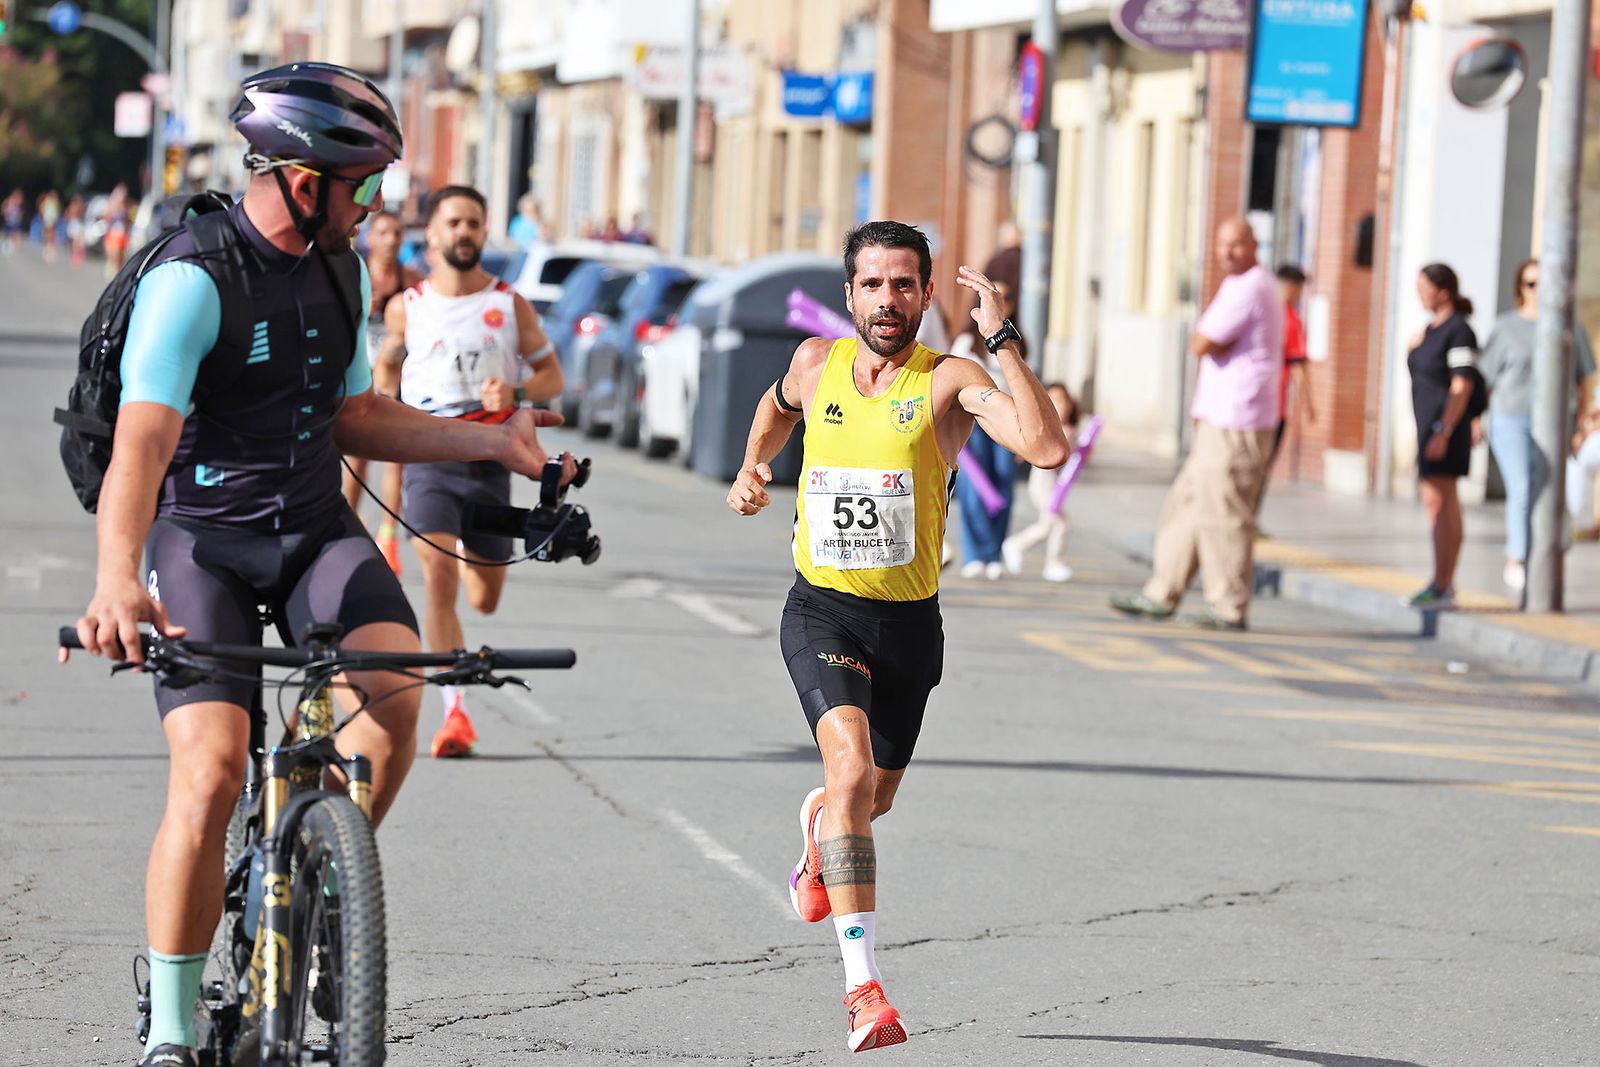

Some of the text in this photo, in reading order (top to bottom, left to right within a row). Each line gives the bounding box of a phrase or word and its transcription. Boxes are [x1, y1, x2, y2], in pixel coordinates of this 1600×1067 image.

[455, 351, 480, 371] 17
[882, 473, 905, 489] 21K
[833, 496, 879, 530] 53
[821, 538, 895, 549] ARTIN BUCETA
